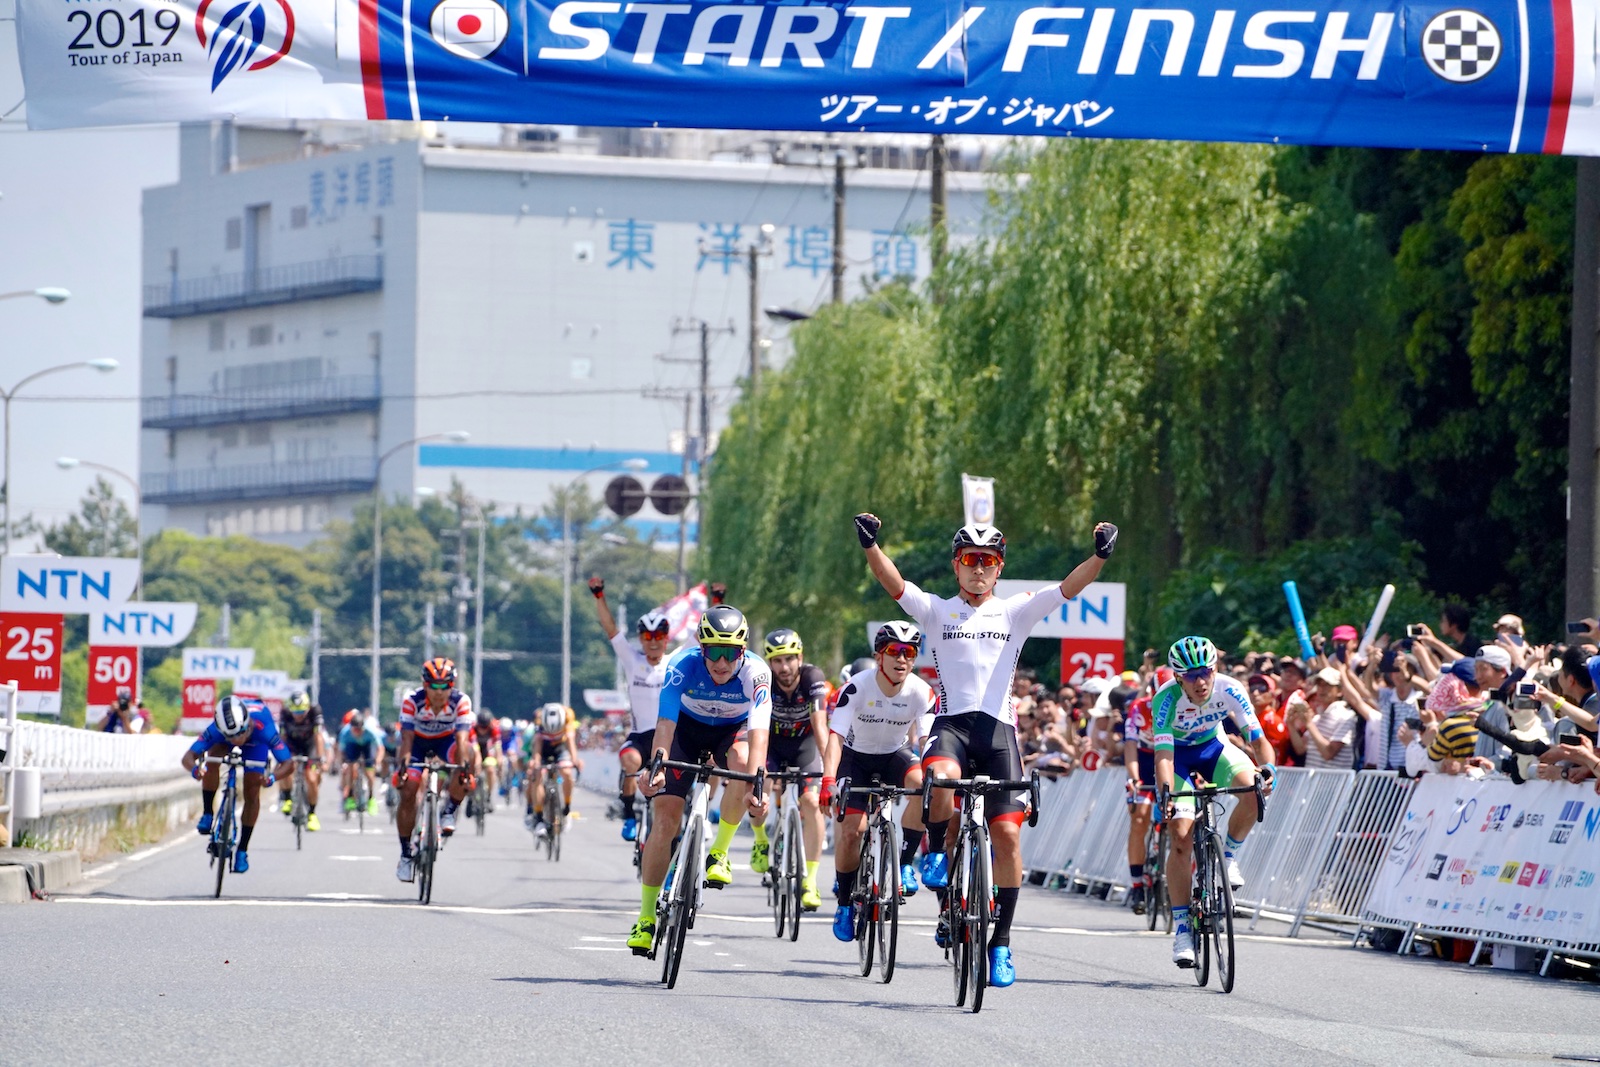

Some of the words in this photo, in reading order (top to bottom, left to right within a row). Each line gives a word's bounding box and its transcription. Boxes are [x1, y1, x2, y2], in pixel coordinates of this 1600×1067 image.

[67, 8, 181, 50] 2019
[538, 2, 911, 69] START
[1001, 8, 1395, 80] FINISH
[68, 53, 108, 67] Tour
[112, 52, 130, 65] of
[133, 50, 183, 67] Japan
[819, 94, 1115, 128] ツアー・オブ・ジャパン
[17, 569, 111, 600] NTN
[103, 612, 175, 636] NTN
[1042, 595, 1109, 625] TN
[943, 624, 963, 632] TEAM
[6, 626, 55, 661] 25
[34, 665, 53, 679] m
[94, 655, 132, 683] 50
[191, 655, 240, 671] NTN
[185, 684, 215, 705] 100
[1224, 687, 1253, 717] MATRIX
[1155, 692, 1174, 729] MATRIX
[1173, 709, 1229, 731] MATRIX
